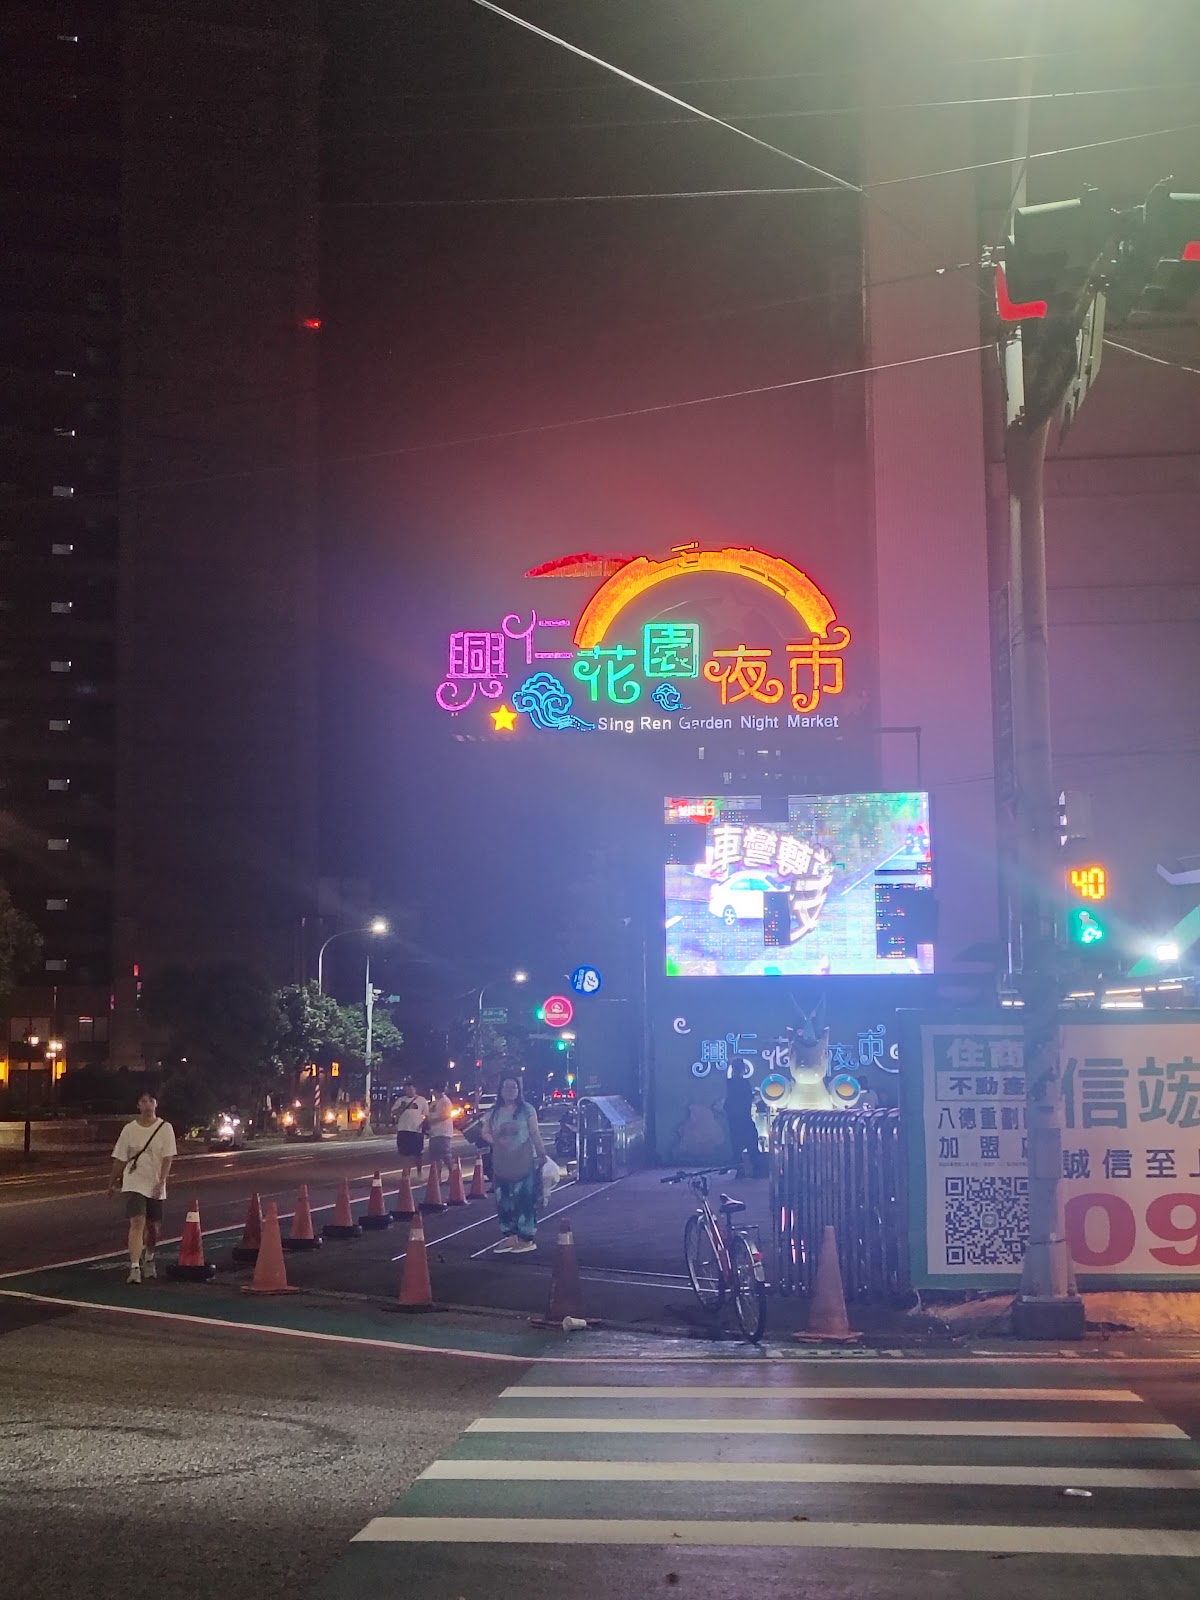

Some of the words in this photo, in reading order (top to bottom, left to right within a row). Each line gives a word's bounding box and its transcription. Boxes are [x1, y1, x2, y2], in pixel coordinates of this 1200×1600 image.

[436, 609, 850, 712] 興仁花園夜市
[598, 717, 634, 733] Sing
[640, 716, 672, 730] Ren
[679, 716, 732, 730] Garden
[740, 715, 779, 731] Night
[787, 714, 839, 728] Market
[1070, 866, 1105, 900] 40
[938, 1107, 1027, 1130] 八德重劃
[939, 1136, 1028, 1159] 加盟
[1064, 1192, 1200, 1267] 09
